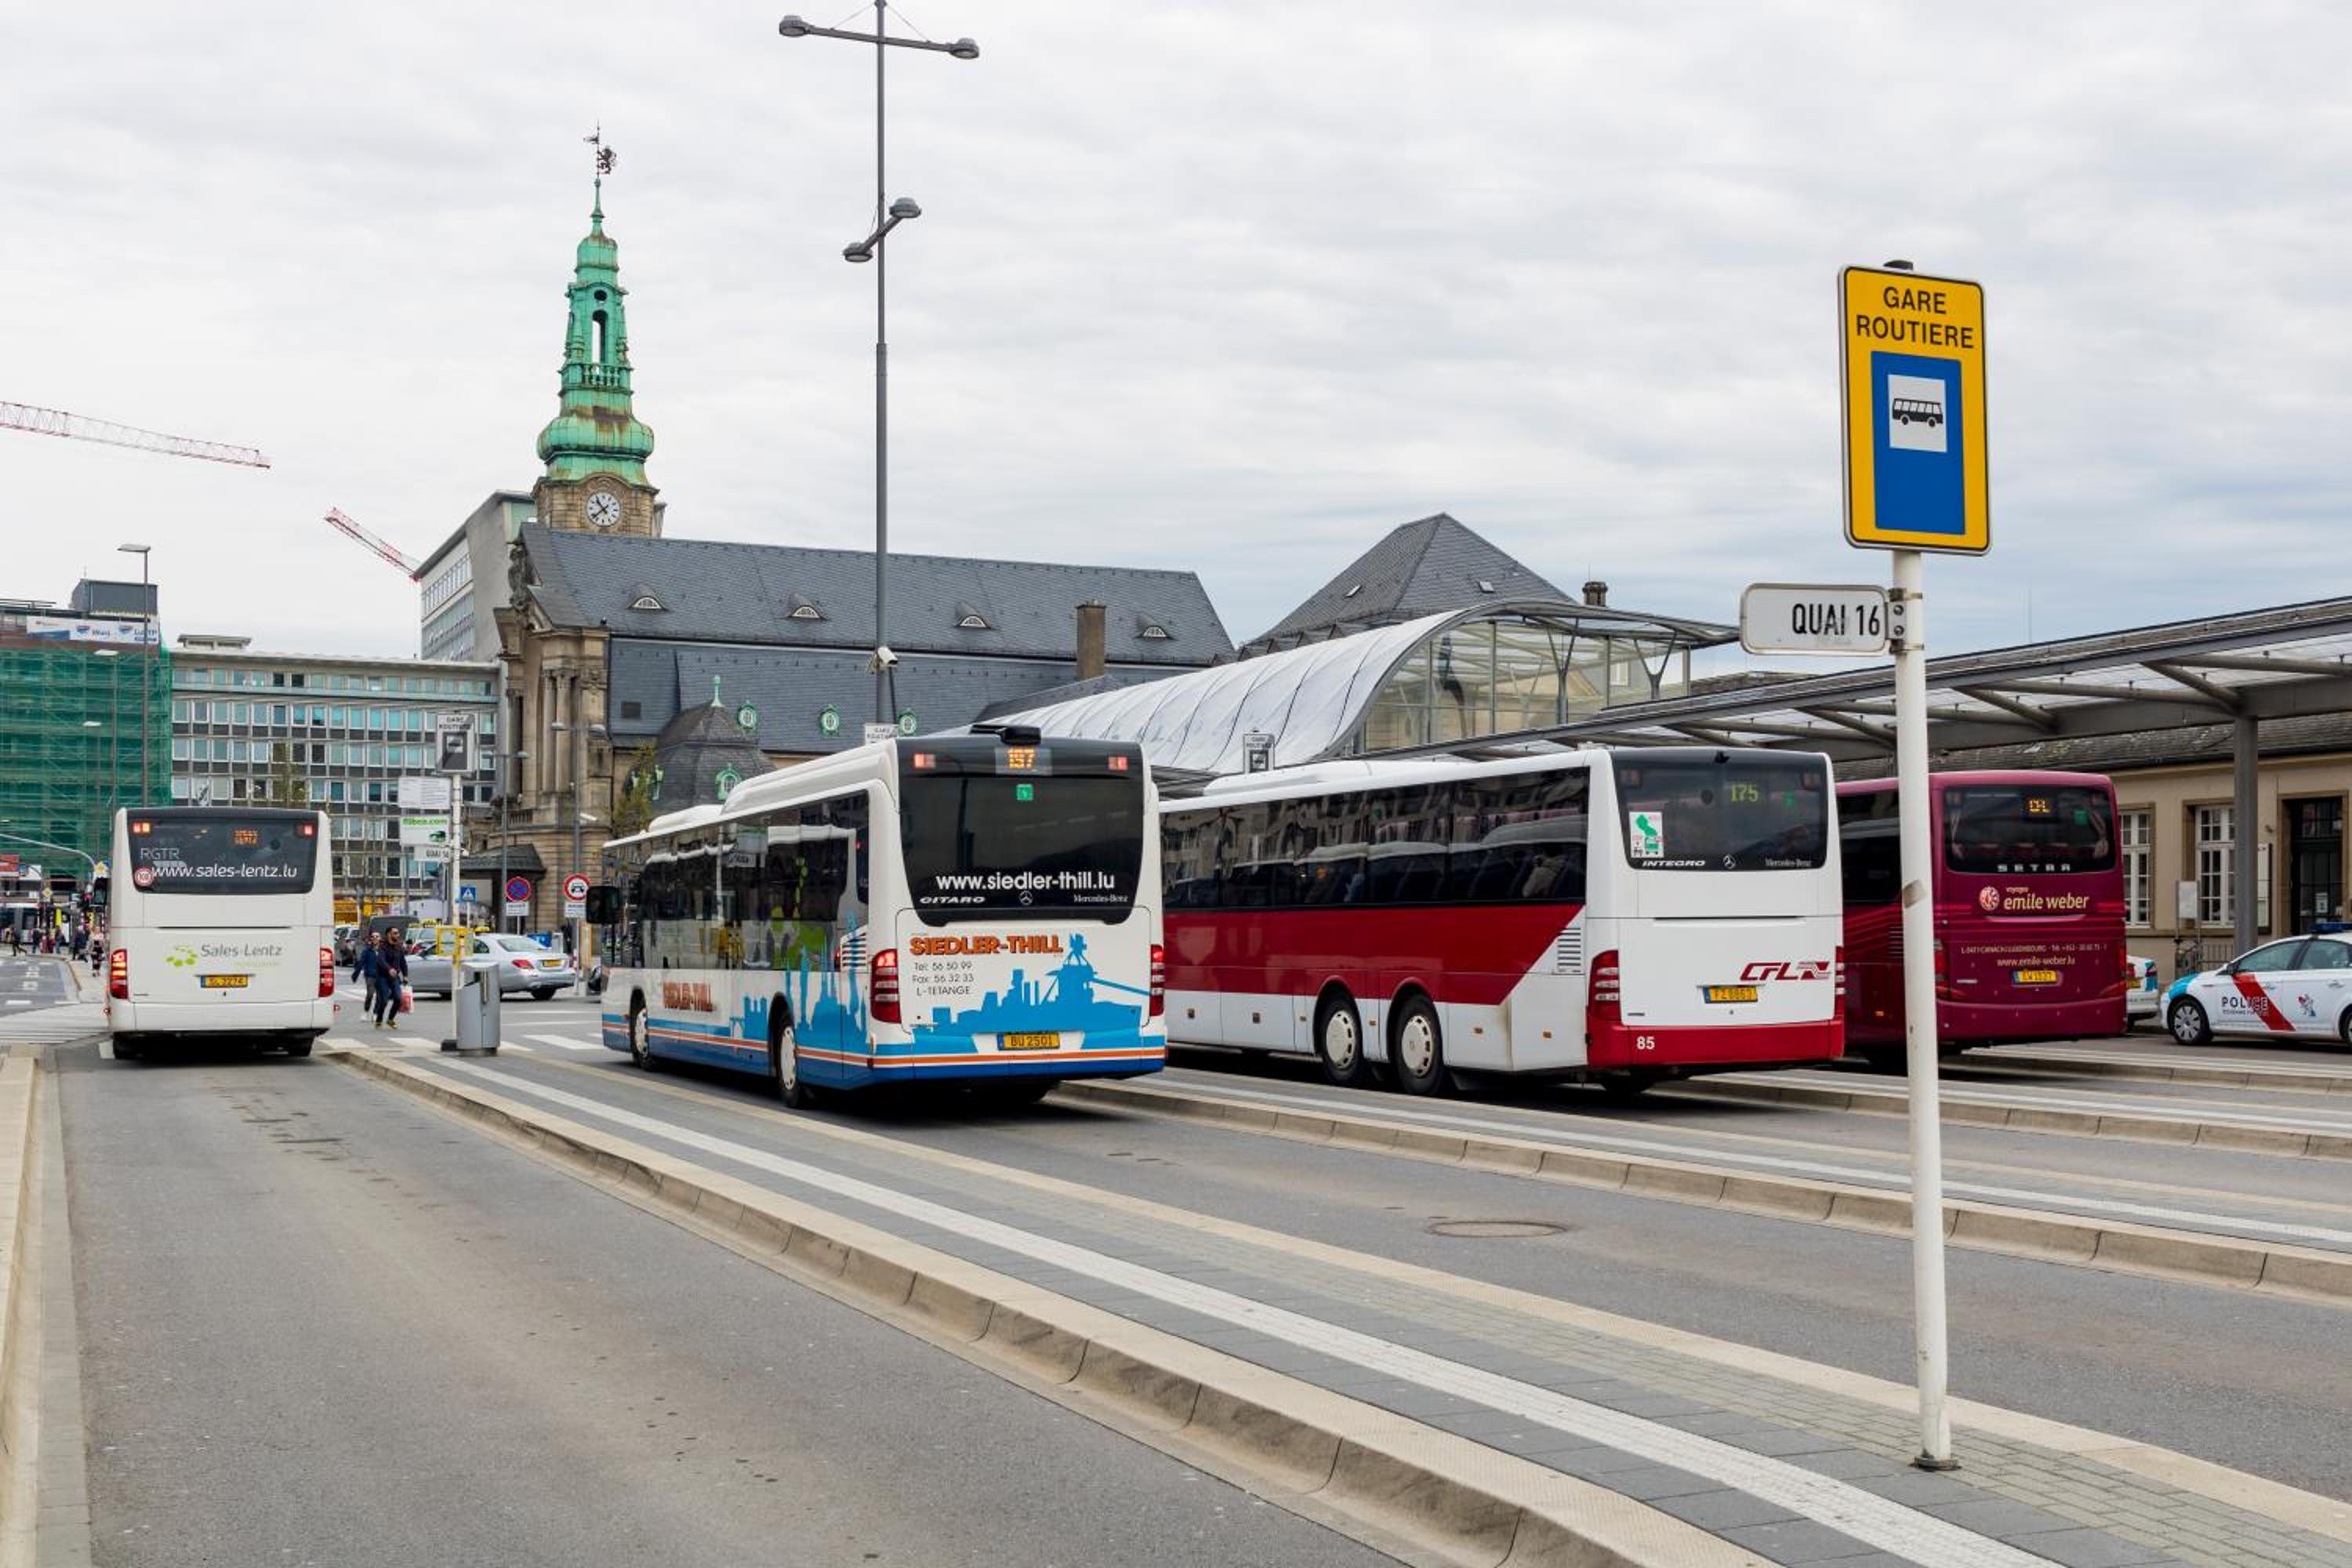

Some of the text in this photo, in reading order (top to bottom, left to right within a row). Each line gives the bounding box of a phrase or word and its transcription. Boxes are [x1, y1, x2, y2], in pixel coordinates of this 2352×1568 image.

[1883, 287, 1947, 314] GARE
[1857, 314, 1974, 349] ROUTIERE
[1792, 604, 1880, 636] QUAI 16
[1730, 782, 1759, 802] 175
[140, 848, 180, 860] RGTR
[1765, 858, 1812, 867] Mercedes-Benz
[151, 863, 298, 878] www.sales-lentz.lu
[936, 871, 1116, 890] www.siedler-thill.lu
[1073, 893, 1129, 902] Mercedes-Benz
[2004, 891, 2090, 909] emile weber
[909, 934, 1064, 956] SIEDLER-THILL
[932, 961, 942, 971] 56
[946, 961, 958, 971] 50
[960, 961, 973, 971] 99
[1997, 956, 2076, 967] www.emile-weber.lu
[933, 974, 945, 983] 56
[947, 974, 960, 983] 32
[962, 973, 975, 982] 33
[1740, 962, 1799, 981] CFL
[2221, 996, 2269, 1011] POLICE
[1011, 1035, 1053, 1047] BU 2501
[1636, 1036, 1656, 1050] 85
